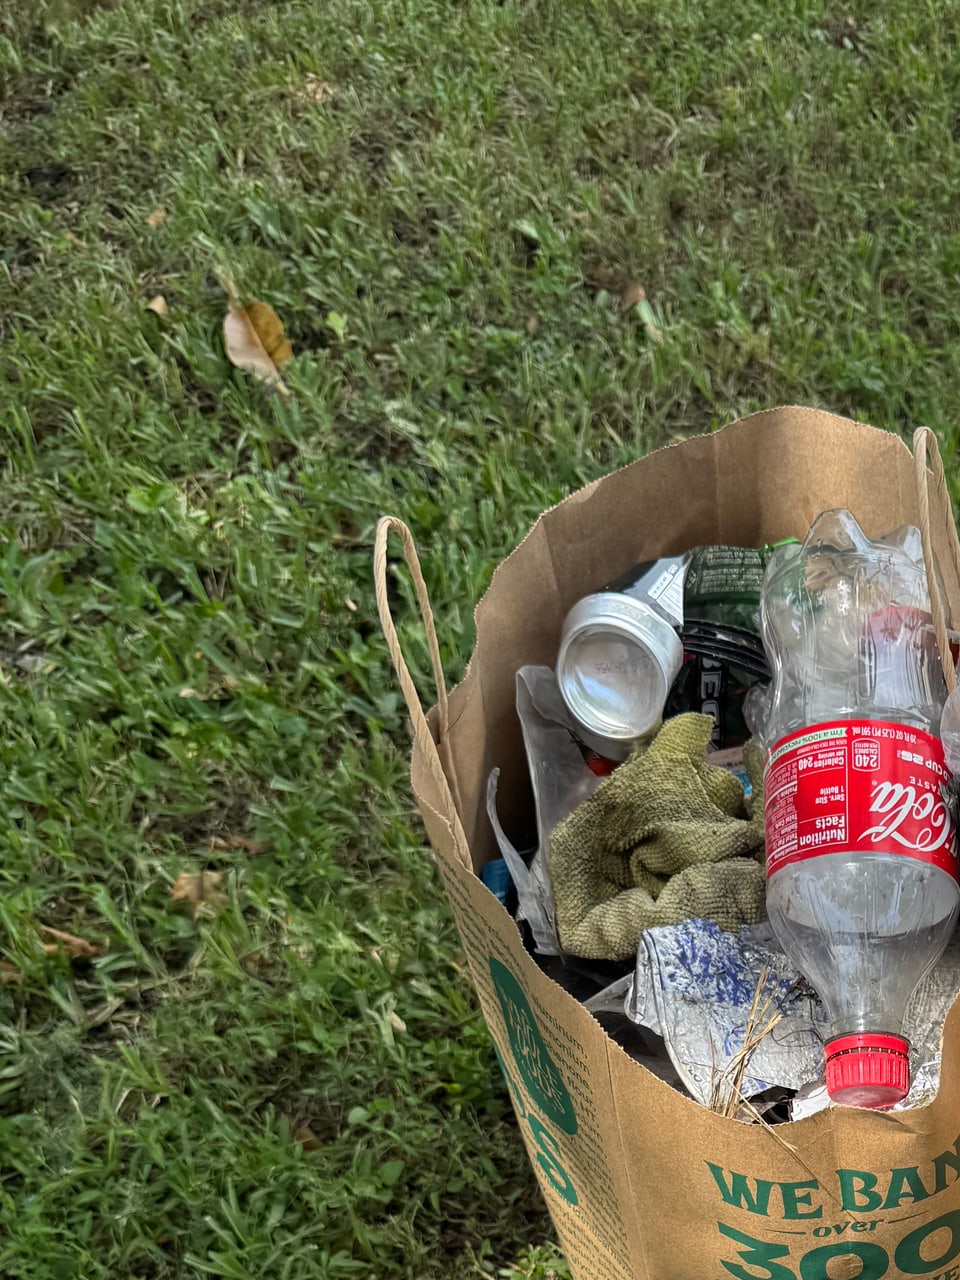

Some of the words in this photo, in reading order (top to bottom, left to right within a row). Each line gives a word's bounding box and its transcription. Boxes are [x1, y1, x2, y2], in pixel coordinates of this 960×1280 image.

[802, 733, 821, 743] 100%
[799, 757, 813, 771] 240
[814, 756, 845, 768] Calories
[854, 754, 878, 768] 240
[925, 759, 942, 774] CUP
[820, 786, 839, 795] Bottle
[815, 797, 828, 805] Size
[816, 815, 845, 829] Facts
[800, 829, 845, 846] Nutrition
[703, 1159, 823, 1221] WE
[812, 1217, 885, 1238] over
